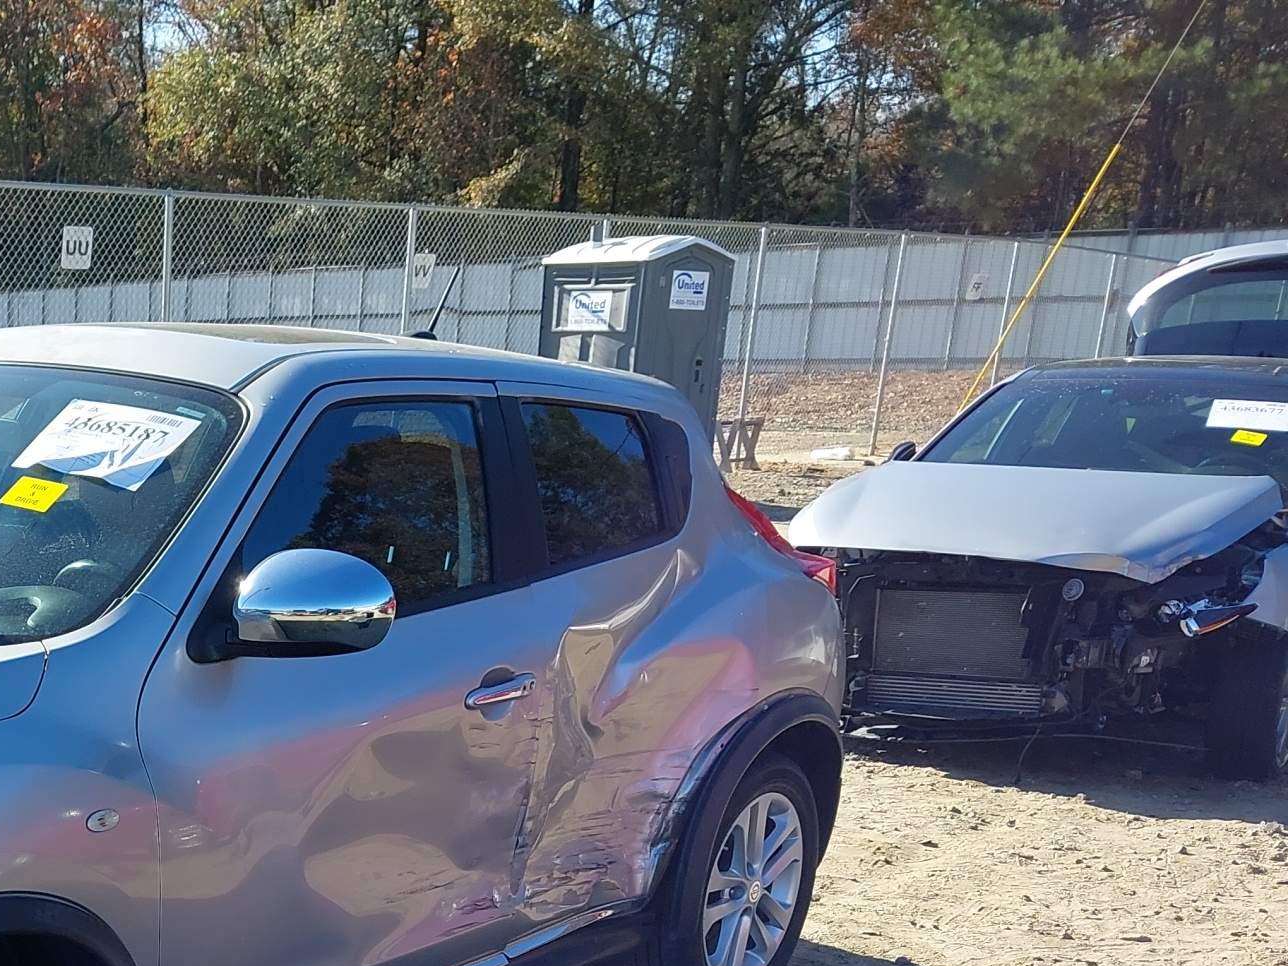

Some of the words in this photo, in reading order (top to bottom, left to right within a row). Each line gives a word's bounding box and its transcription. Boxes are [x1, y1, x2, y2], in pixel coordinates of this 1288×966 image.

[66, 239, 89, 256] UU
[677, 278, 705, 290] United
[574, 298, 606, 310] United
[64, 416, 170, 445] 43685187
[30, 483, 49, 491] RUN
[15, 495, 40, 505] DRIVE
